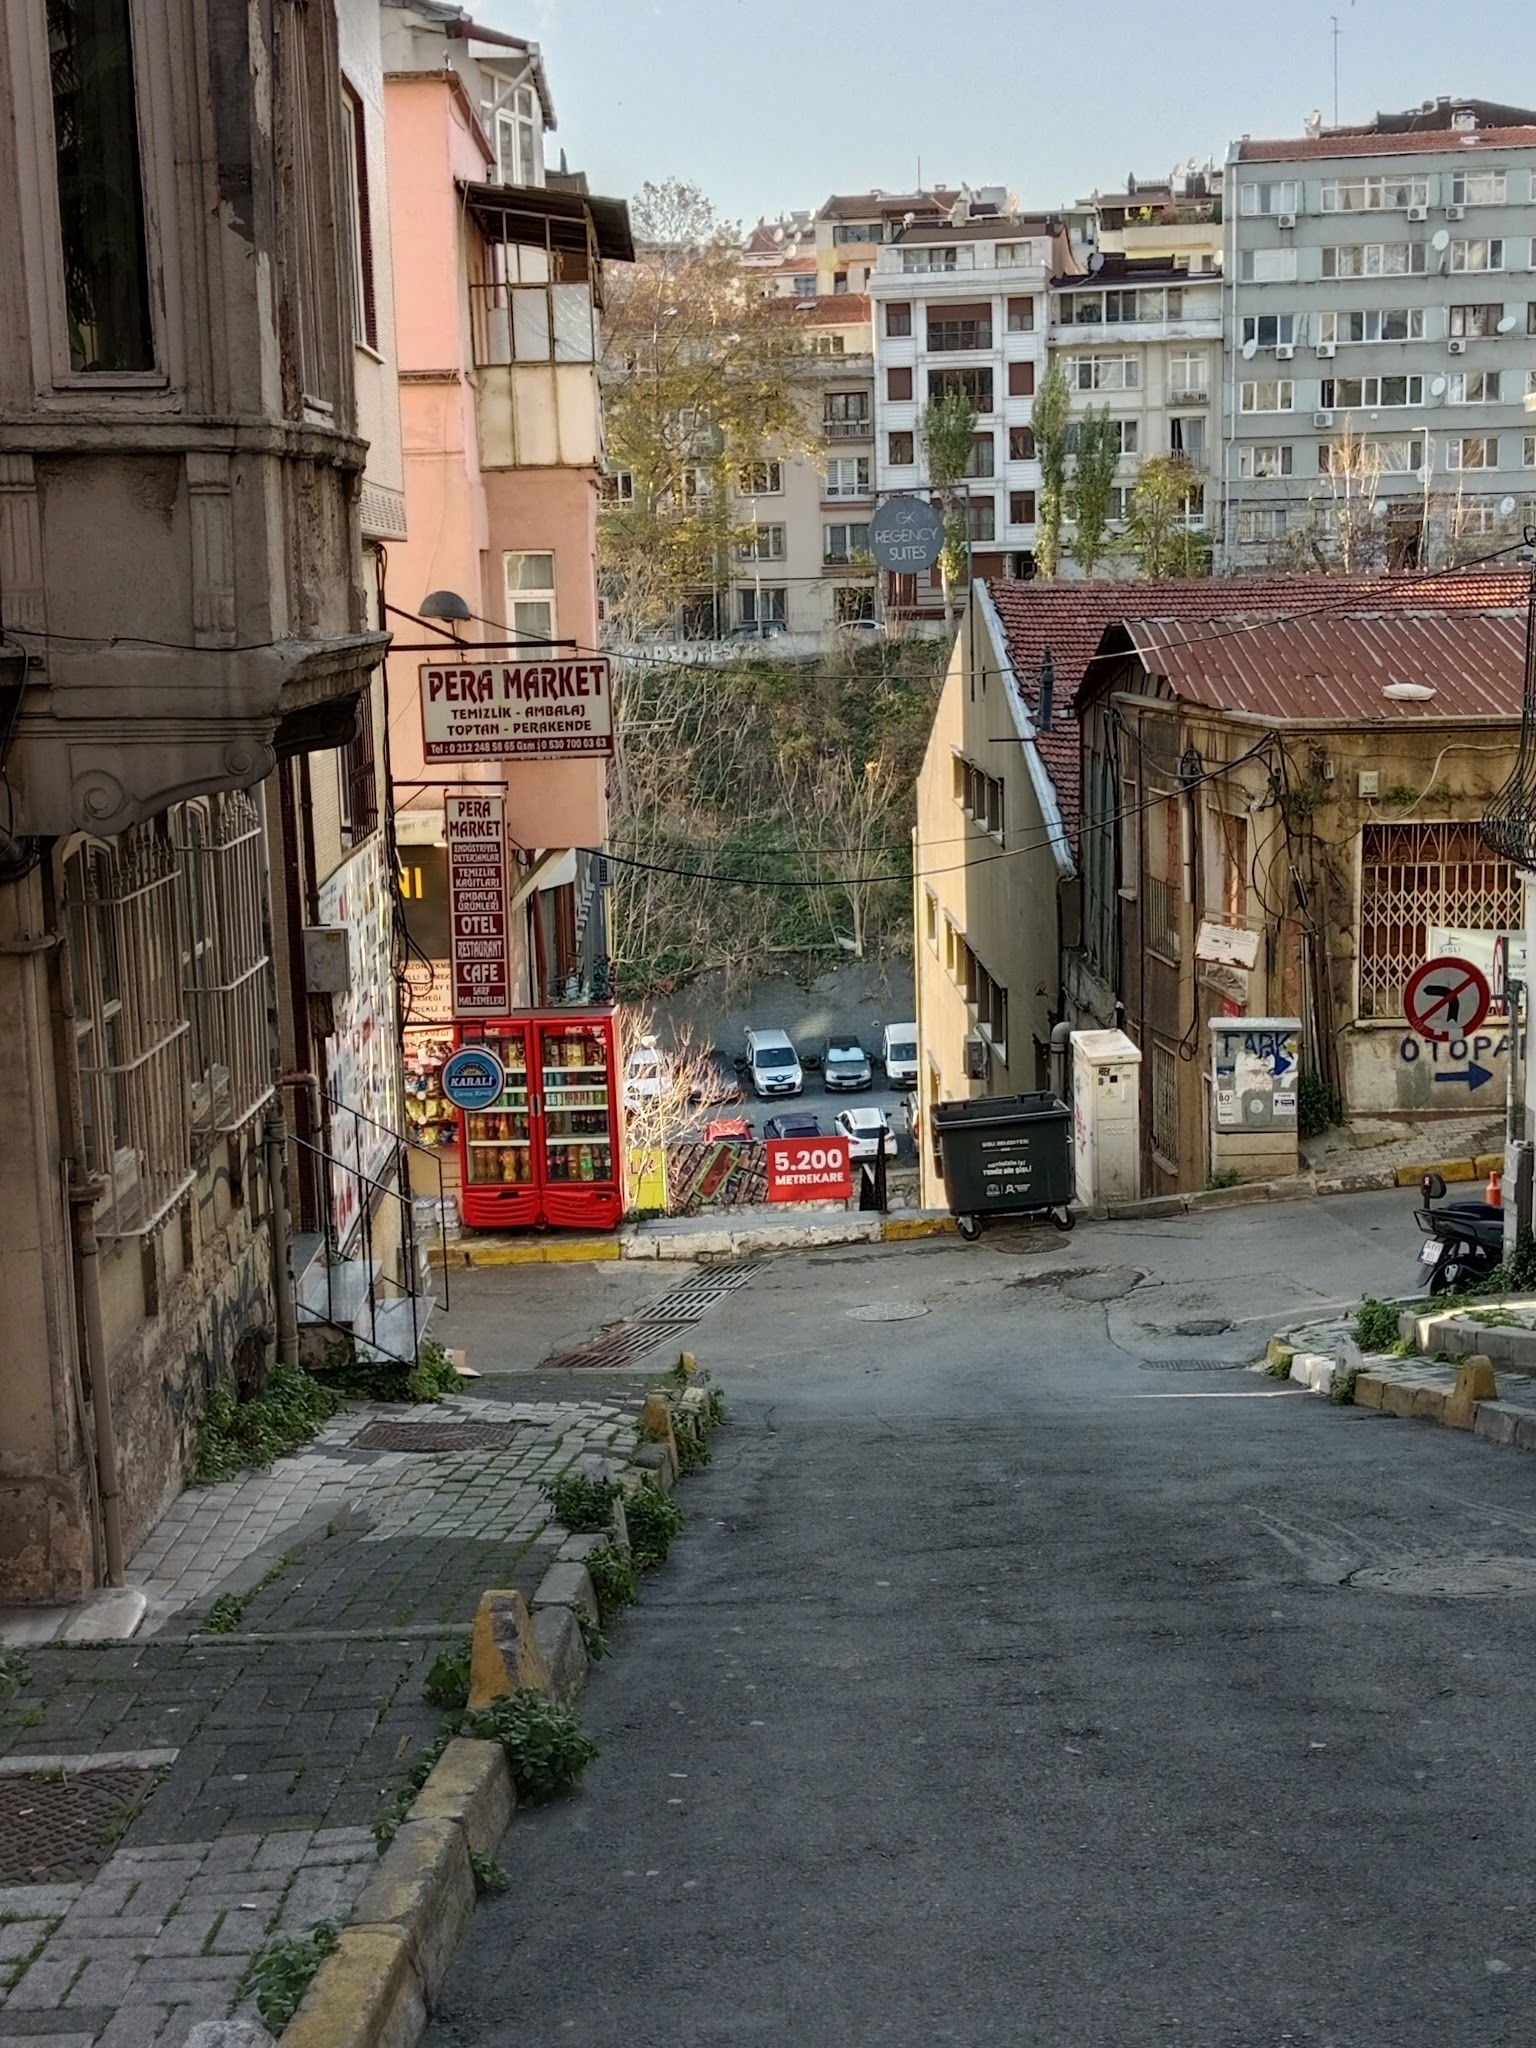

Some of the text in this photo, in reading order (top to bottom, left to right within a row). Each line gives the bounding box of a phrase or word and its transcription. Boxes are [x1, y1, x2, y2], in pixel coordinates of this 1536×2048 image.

[874, 527, 939, 544] REGENCY
[889, 545, 927, 561] SUITES
[428, 665, 605, 704] PERA MARKET
[525, 704, 586, 718] AMBALAJ
[446, 723, 500, 736] TOPTAN
[513, 720, 592, 734] PERAKENDE
[456, 743, 473, 753] 212
[566, 738, 582, 749] 700
[458, 801, 491, 818] PERA
[449, 821, 501, 838] MARKET
[459, 891, 498, 901] AMBALAJ
[461, 916, 497, 934] OTEL
[457, 940, 502, 958] RESTAURANT
[462, 964, 499, 983] CAFE
[472, 986, 490, 996] SARF
[774, 1148, 843, 1172] 5.200
[774, 1172, 844, 1186] METREKARE
